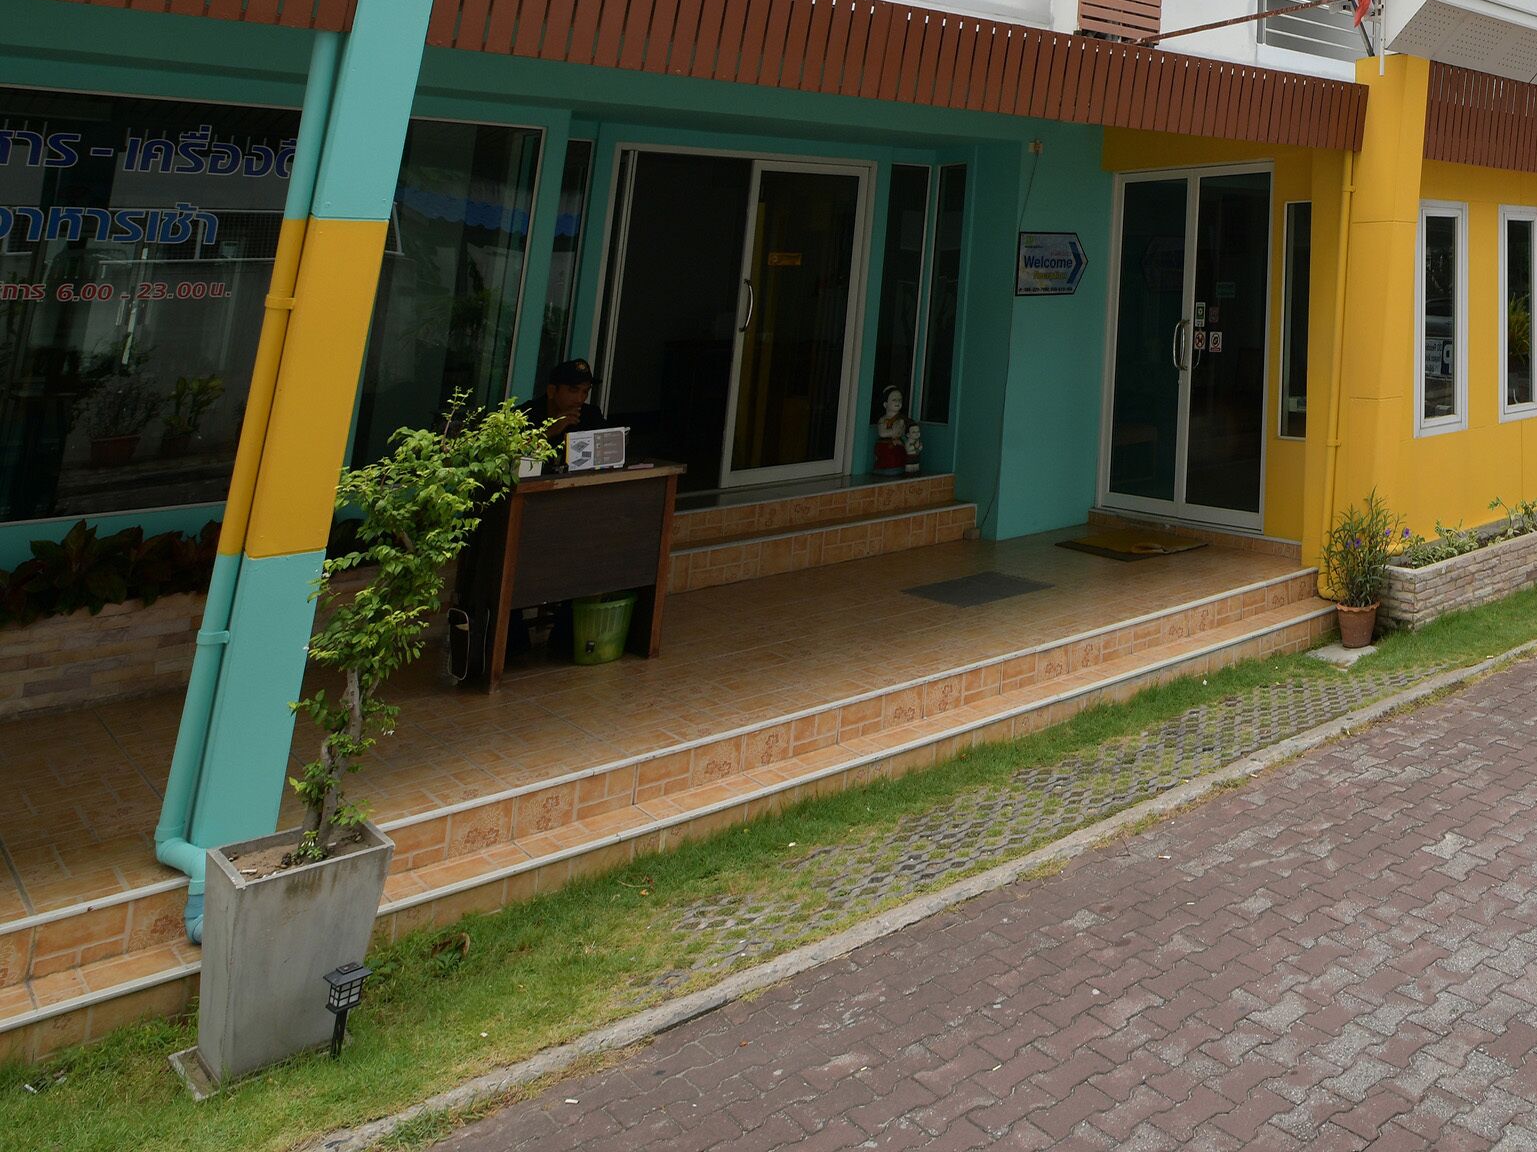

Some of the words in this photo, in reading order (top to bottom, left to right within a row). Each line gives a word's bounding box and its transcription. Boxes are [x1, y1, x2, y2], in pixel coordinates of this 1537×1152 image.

[1023, 255, 1073, 268] Welcome
[0, 281, 46, 301] การ
[56, 283, 114, 302] 6.00
